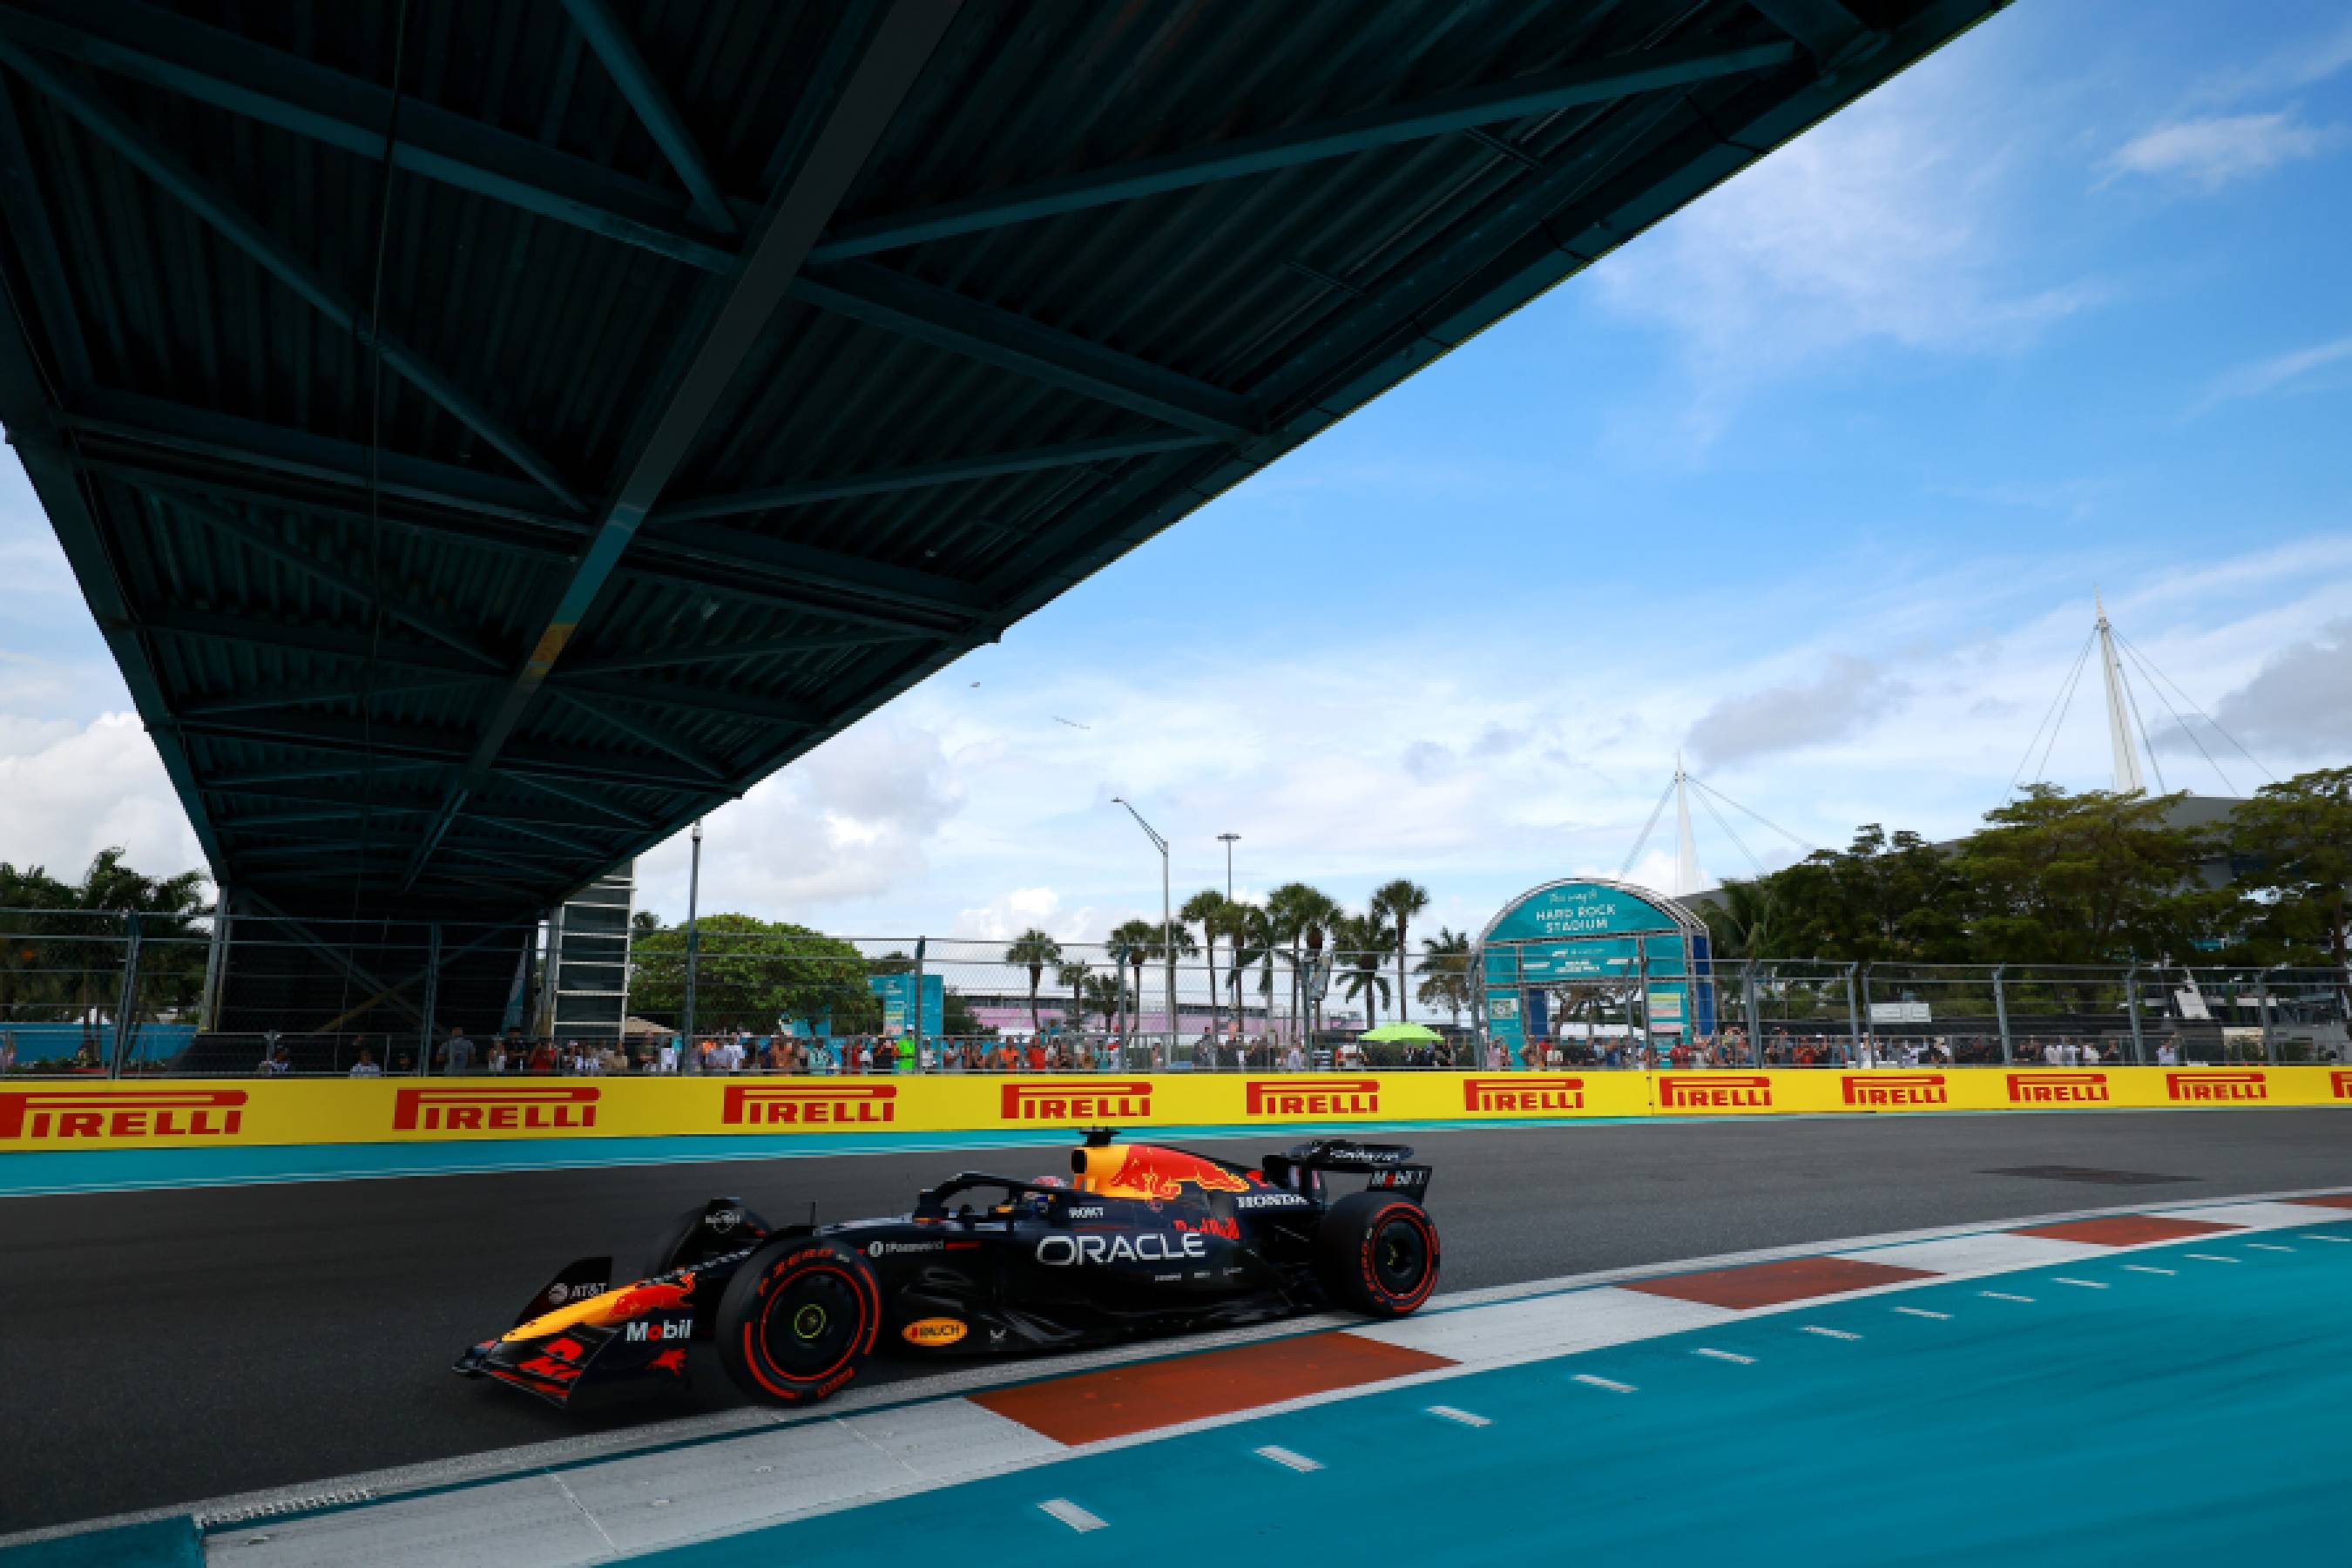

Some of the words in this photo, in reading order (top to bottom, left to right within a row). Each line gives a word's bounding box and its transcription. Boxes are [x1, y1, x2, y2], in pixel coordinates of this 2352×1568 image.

[1535, 909, 1574, 921] HARD
[1578, 903, 1616, 918] ROCK
[1545, 917, 1609, 934] STADIUM
[1001, 1082, 1153, 1119] PIRELLI
[1247, 1079, 1381, 1114] PIRELLI
[1463, 1078, 1585, 1111] PIRELLI
[1659, 1076, 1772, 1106] PIRELLI
[1841, 1074, 1947, 1105] PIRELLI
[2006, 1073, 2109, 1102] PIRELLI
[2166, 1071, 2267, 1101] PIRELLI
[0, 1090, 248, 1139] PIRELLI
[392, 1087, 601, 1132] PIRELLI
[722, 1084, 897, 1125] PIRELLI
[1235, 1193, 1310, 1209] HONDA
[1037, 1233, 1206, 1266] ORACLE
[570, 1281, 608, 1300] AT&T
[625, 1319, 693, 1343] Mobil
